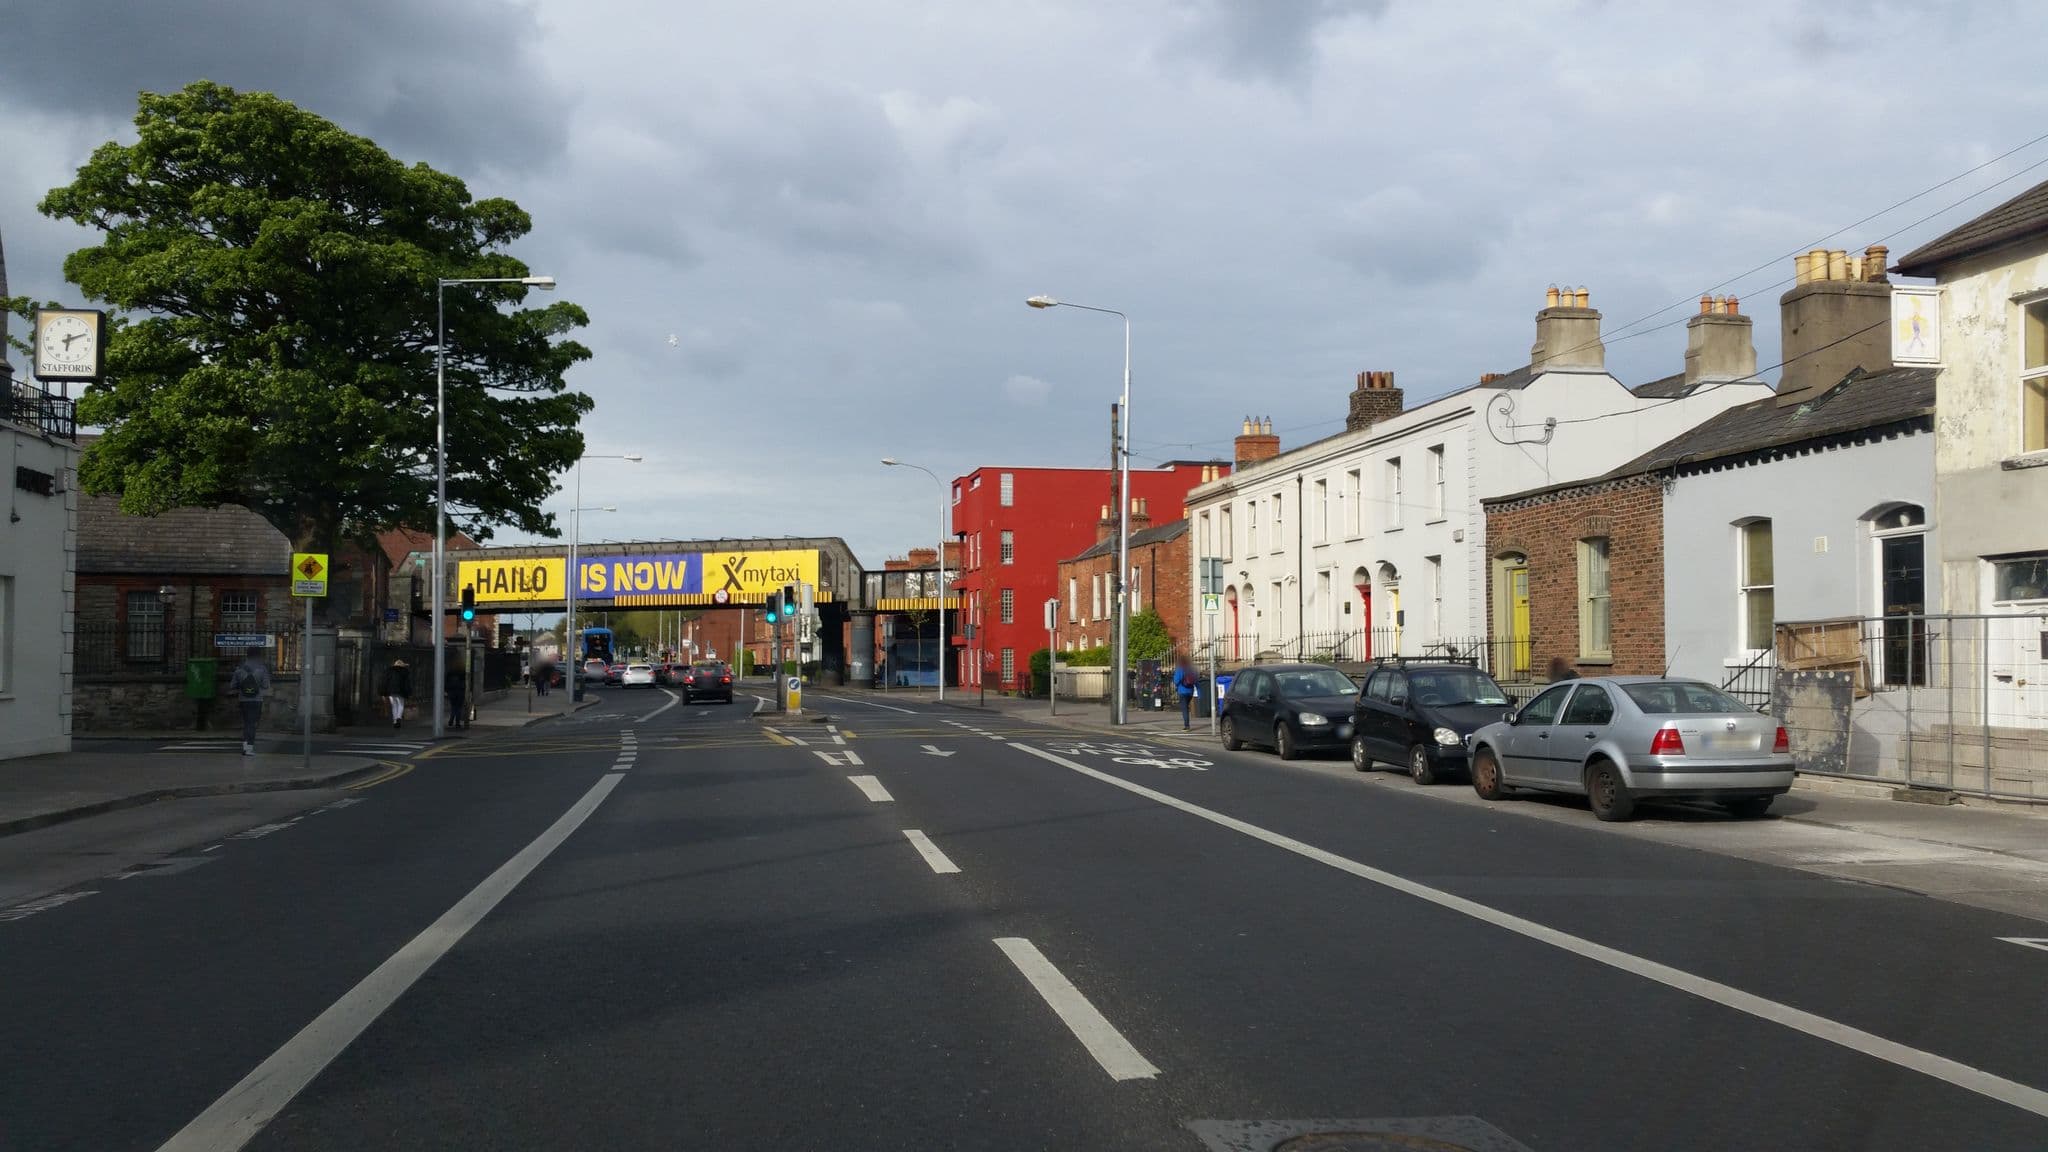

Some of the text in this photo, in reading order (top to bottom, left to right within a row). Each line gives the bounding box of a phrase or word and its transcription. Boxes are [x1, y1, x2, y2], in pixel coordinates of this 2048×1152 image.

[41, 363, 93, 373] STAFFORDS
[476, 560, 799, 594] HAILO IS NOW mytaxi
